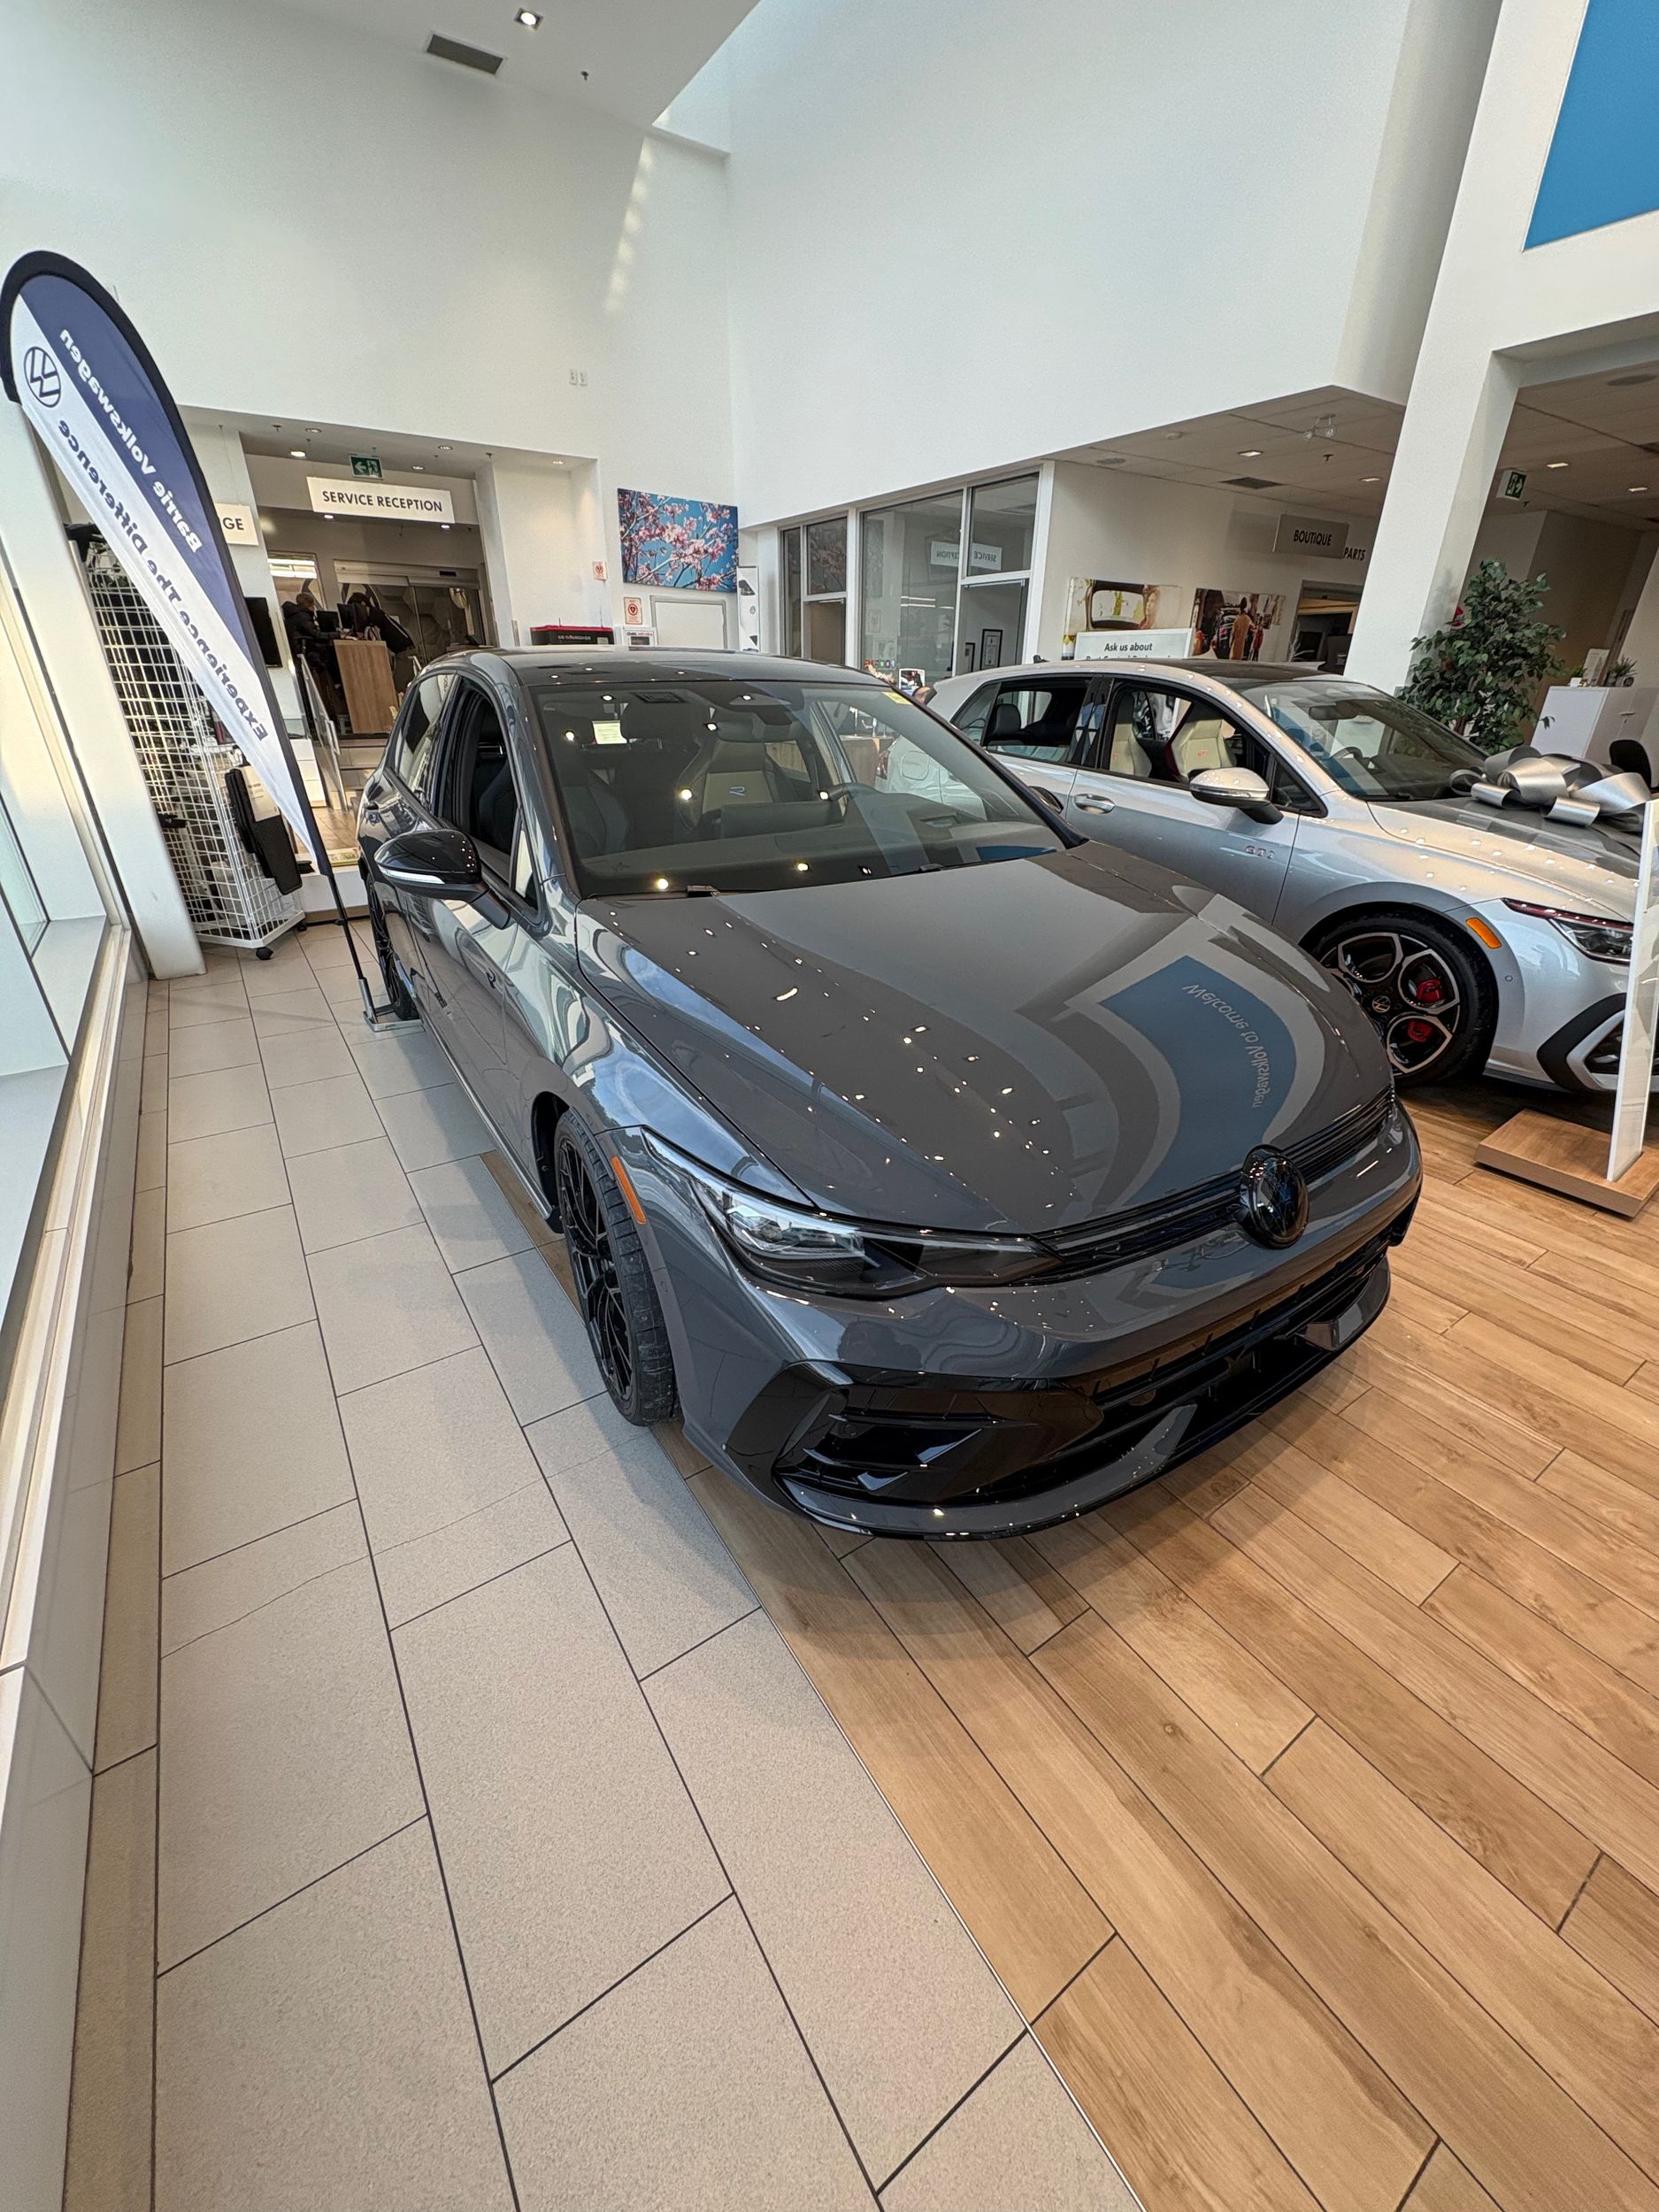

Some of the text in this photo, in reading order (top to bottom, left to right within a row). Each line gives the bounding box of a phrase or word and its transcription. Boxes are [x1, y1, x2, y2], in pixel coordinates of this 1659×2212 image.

[322, 490, 443, 512] SERVICE RECEPTION
[1293, 530, 1333, 546] BOUTIQUE
[1343, 547, 1366, 561] PARTS
[1104, 642, 1118, 651] Ask
[1129, 642, 1153, 651] about
